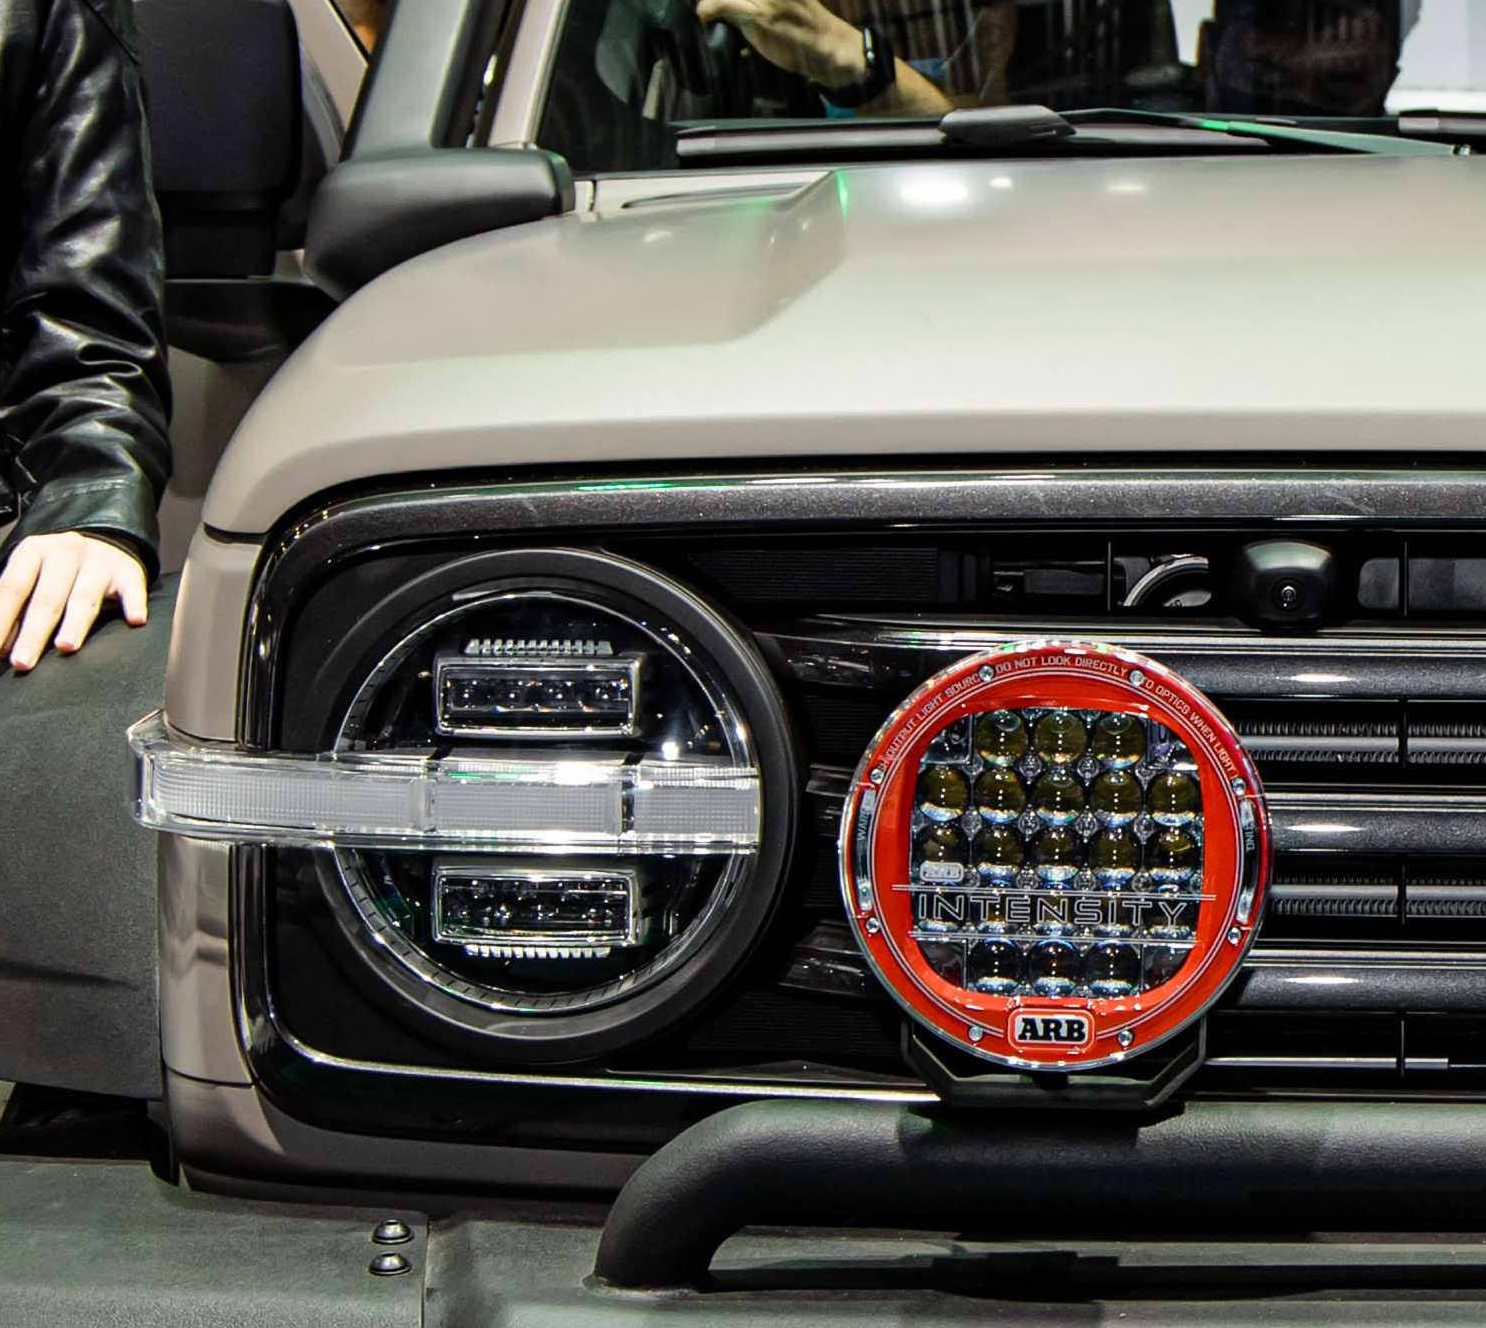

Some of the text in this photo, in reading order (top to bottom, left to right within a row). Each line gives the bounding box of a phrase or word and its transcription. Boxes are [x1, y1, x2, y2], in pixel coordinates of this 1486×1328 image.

[914, 691, 947, 721] LIGHT
[943, 671, 982, 698] SOURC
[994, 660, 1012, 674] DO
[1013, 656, 1038, 669] NOT
[1040, 655, 1071, 666] LOOK
[1074, 656, 1128, 678] DIRECTLY
[1154, 684, 1191, 715] OPTICS
[1187, 711, 1217, 743] WHEN
[1211, 741, 1236, 773] LIGHT
[918, 893, 1187, 927] INTENSITY
[1017, 1017, 1087, 1042] ARB
